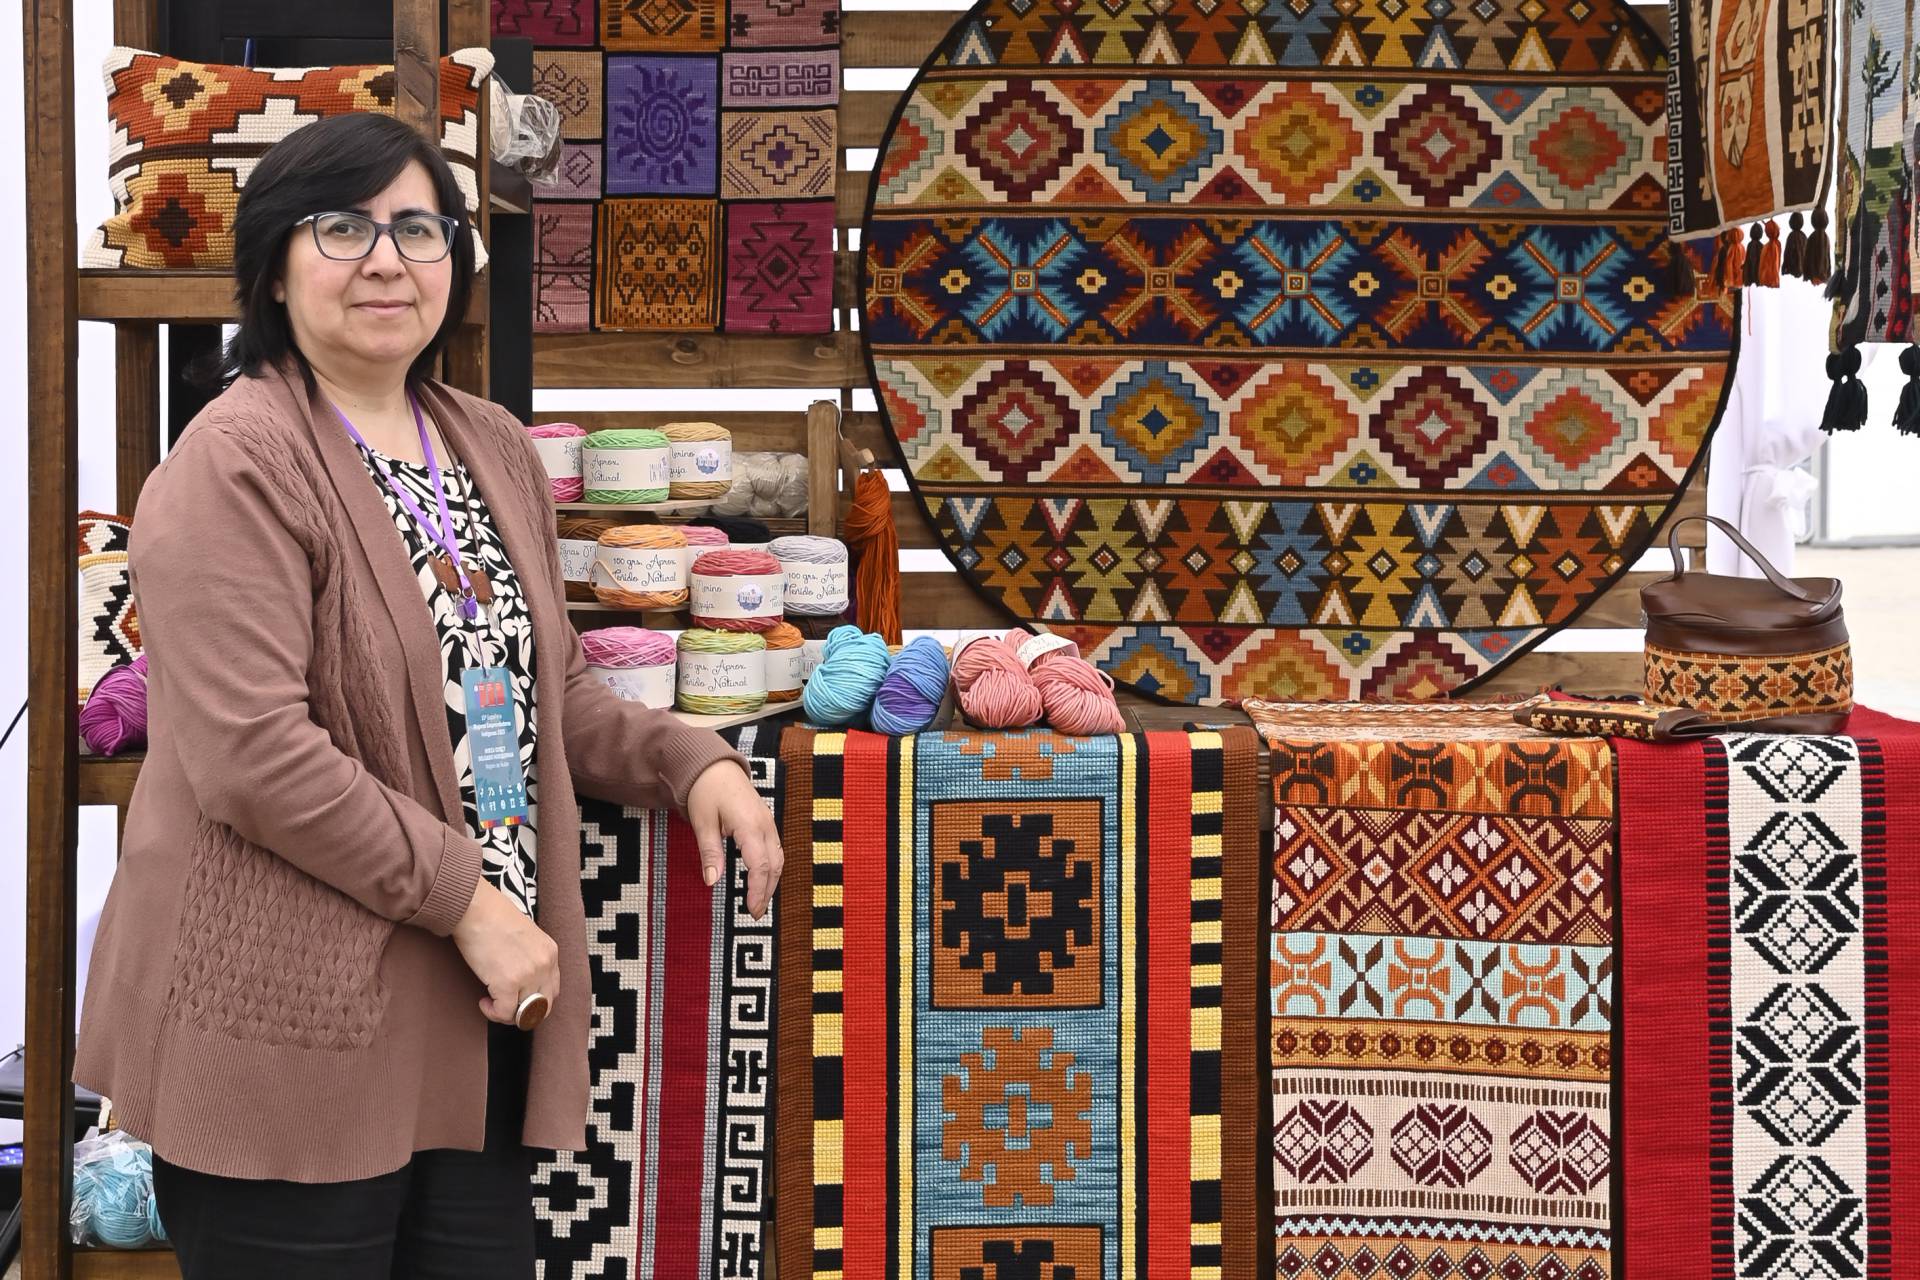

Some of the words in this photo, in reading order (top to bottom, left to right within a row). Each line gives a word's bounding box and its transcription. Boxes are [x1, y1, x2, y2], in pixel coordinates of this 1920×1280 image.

[587, 470, 621, 486] Natural
[641, 569, 677, 586] Natural
[707, 675, 749, 692] Natural
